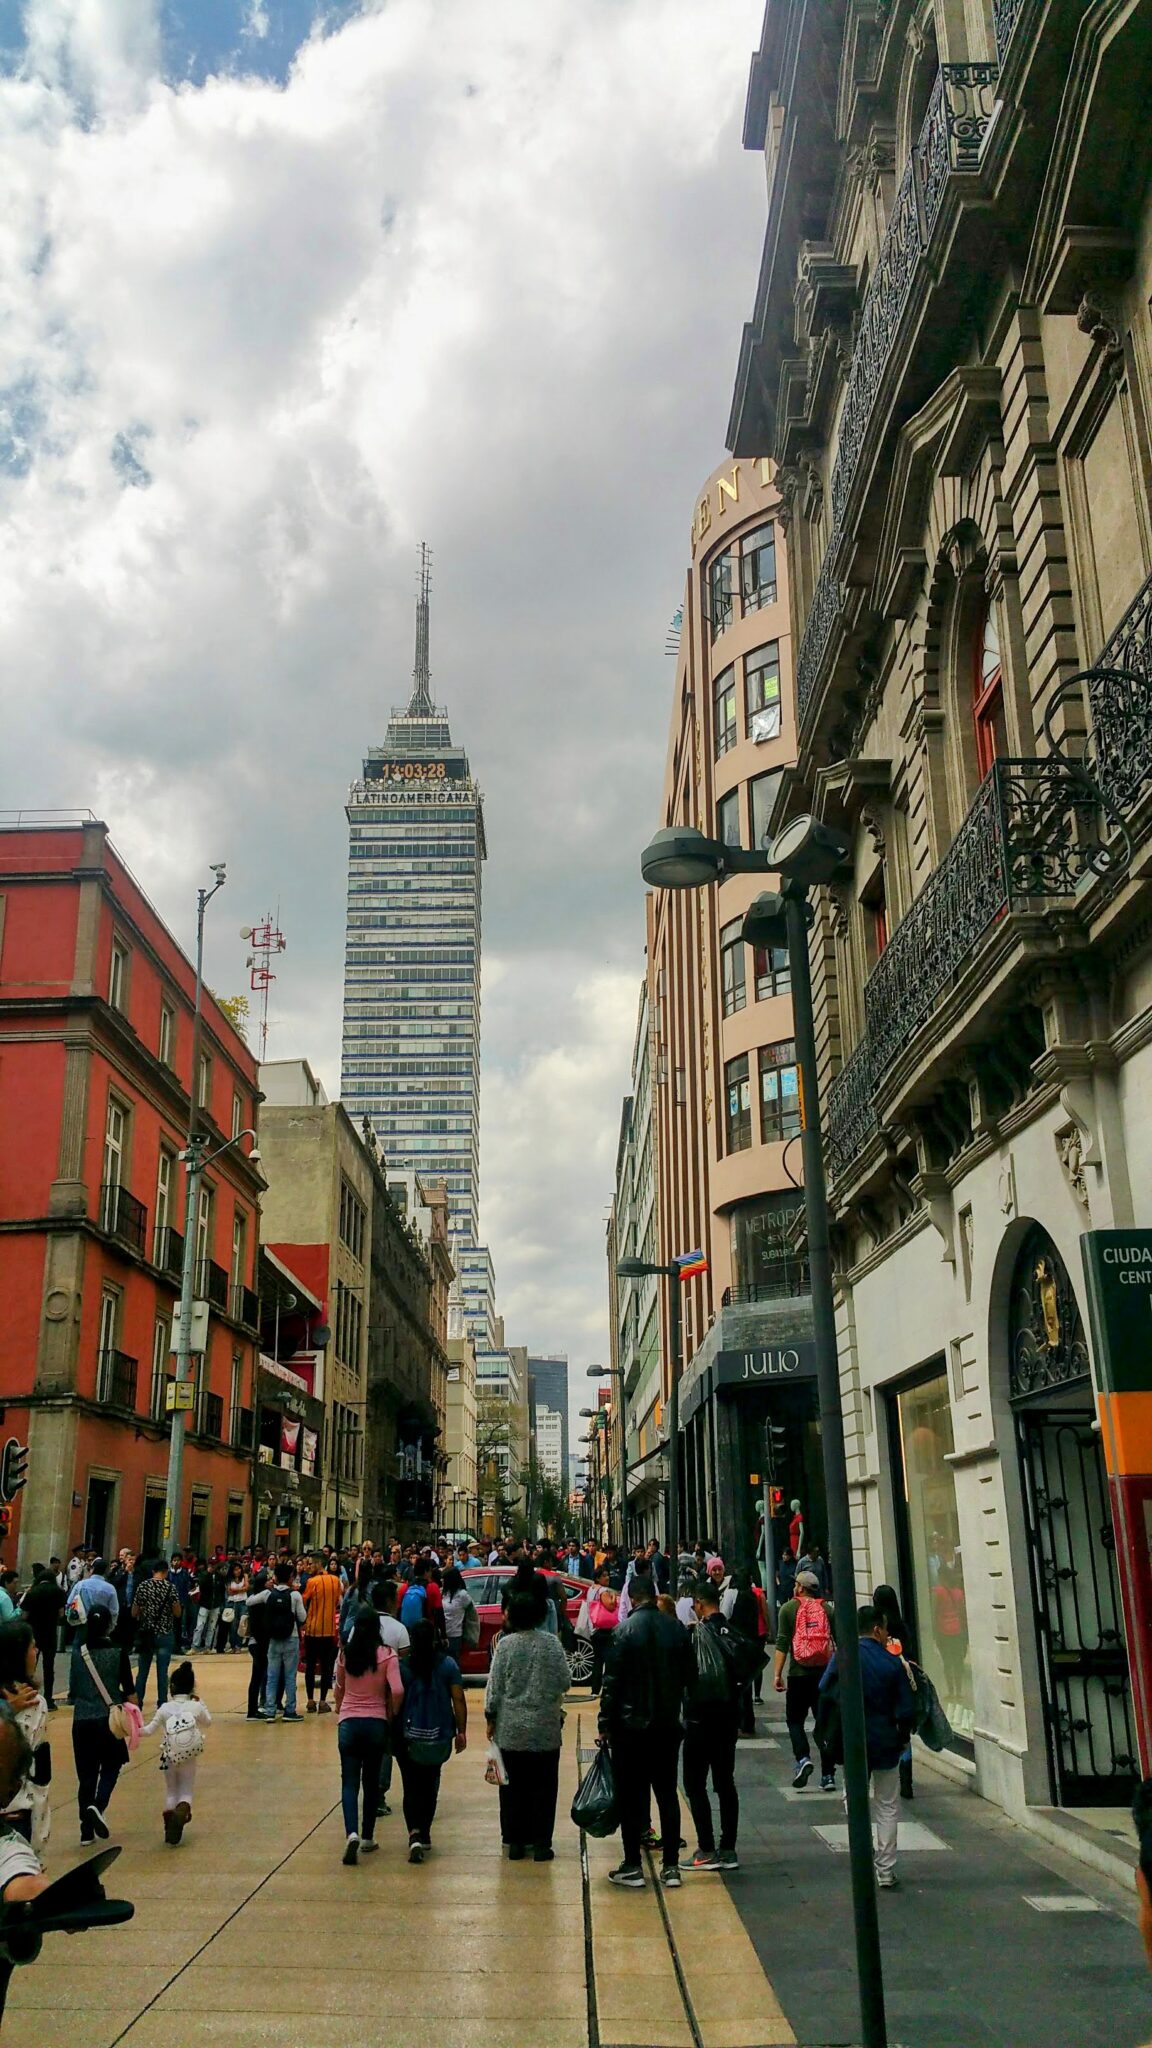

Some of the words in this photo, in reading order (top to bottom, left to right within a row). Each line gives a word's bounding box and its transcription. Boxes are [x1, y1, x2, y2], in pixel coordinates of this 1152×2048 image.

[382, 763, 446, 778] 13:03:28
[356, 792, 471, 804] LATINOAMERICANA
[1103, 1247, 1152, 1264] CIUDA
[1119, 1270, 1152, 1284] CENT
[742, 1350, 799, 1379] JULIO
